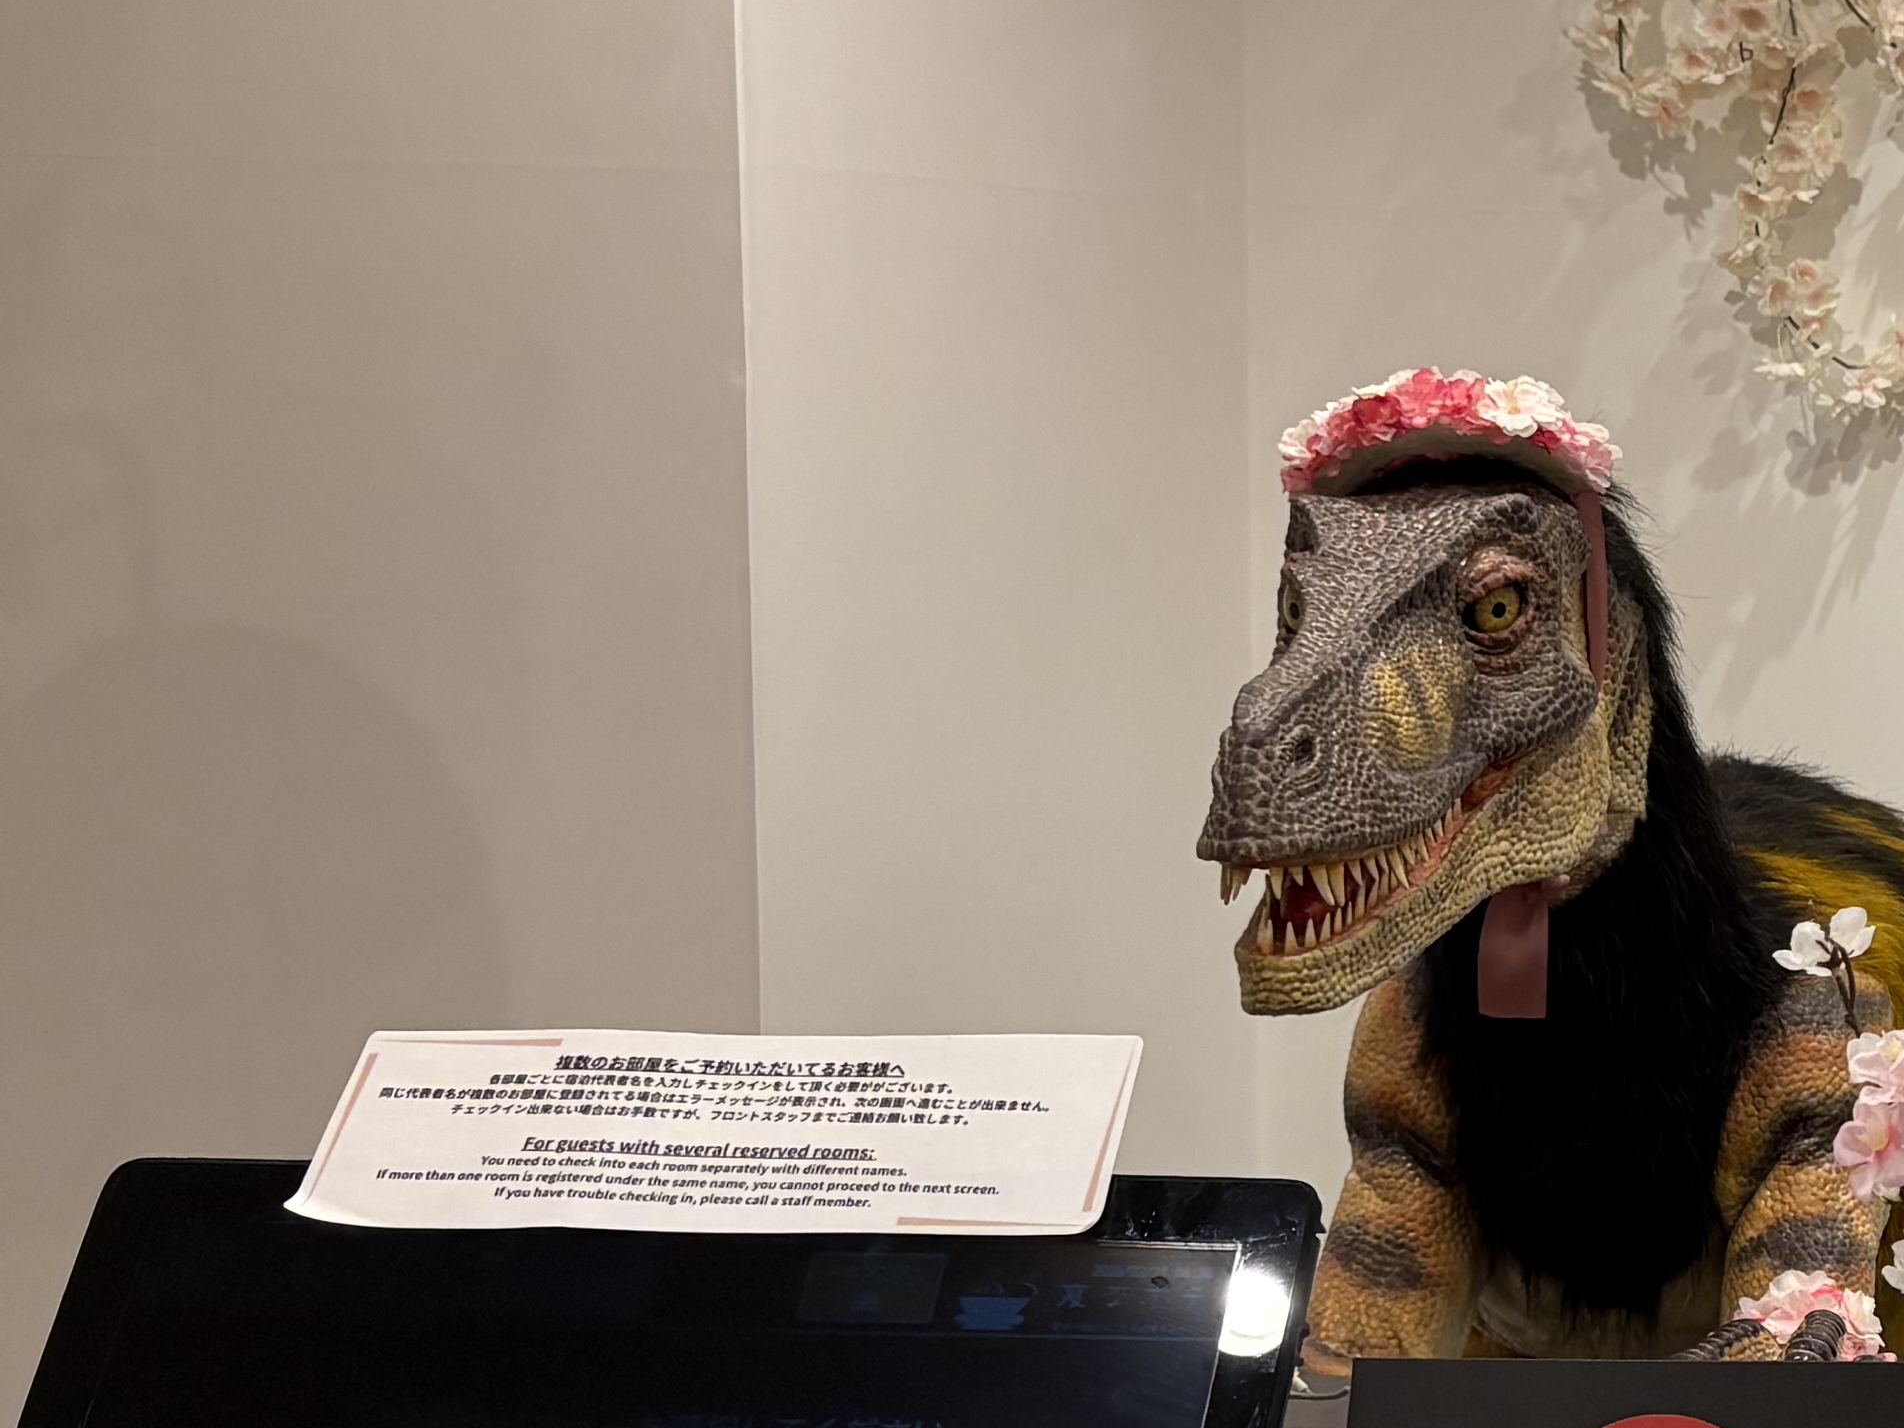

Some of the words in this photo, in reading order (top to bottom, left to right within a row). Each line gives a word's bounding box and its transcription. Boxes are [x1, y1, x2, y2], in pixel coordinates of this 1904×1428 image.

[520, 1136, 555, 1152] For
[553, 1138, 615, 1153] guests
[613, 1139, 660, 1156] with
[658, 1142, 730, 1158] several
[727, 1143, 810, 1160] reserved
[808, 1147, 874, 1161] rooms:
